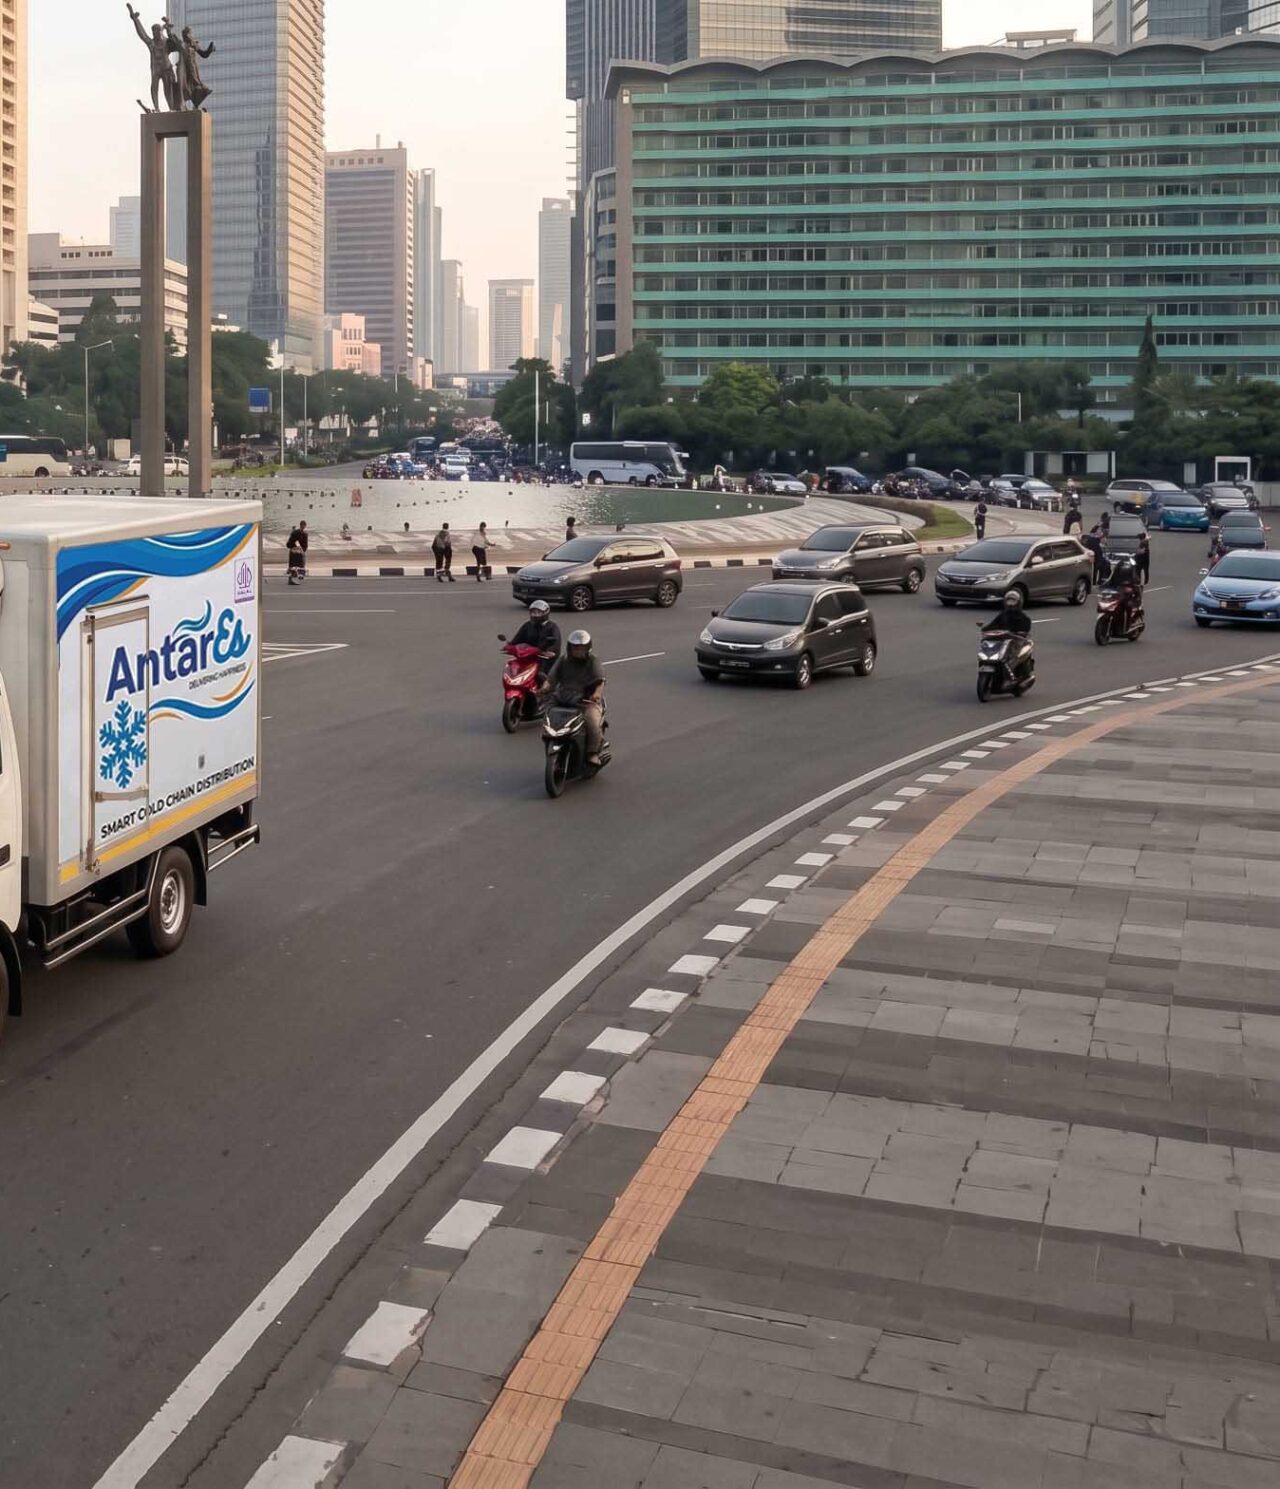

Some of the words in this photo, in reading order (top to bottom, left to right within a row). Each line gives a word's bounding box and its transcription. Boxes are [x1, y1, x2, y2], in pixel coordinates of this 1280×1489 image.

[101, 811, 136, 839] SMART
[138, 799, 164, 821] COLD
[166, 784, 195, 807] CHAIN
[197, 756, 255, 792] DISTRIBUTION
